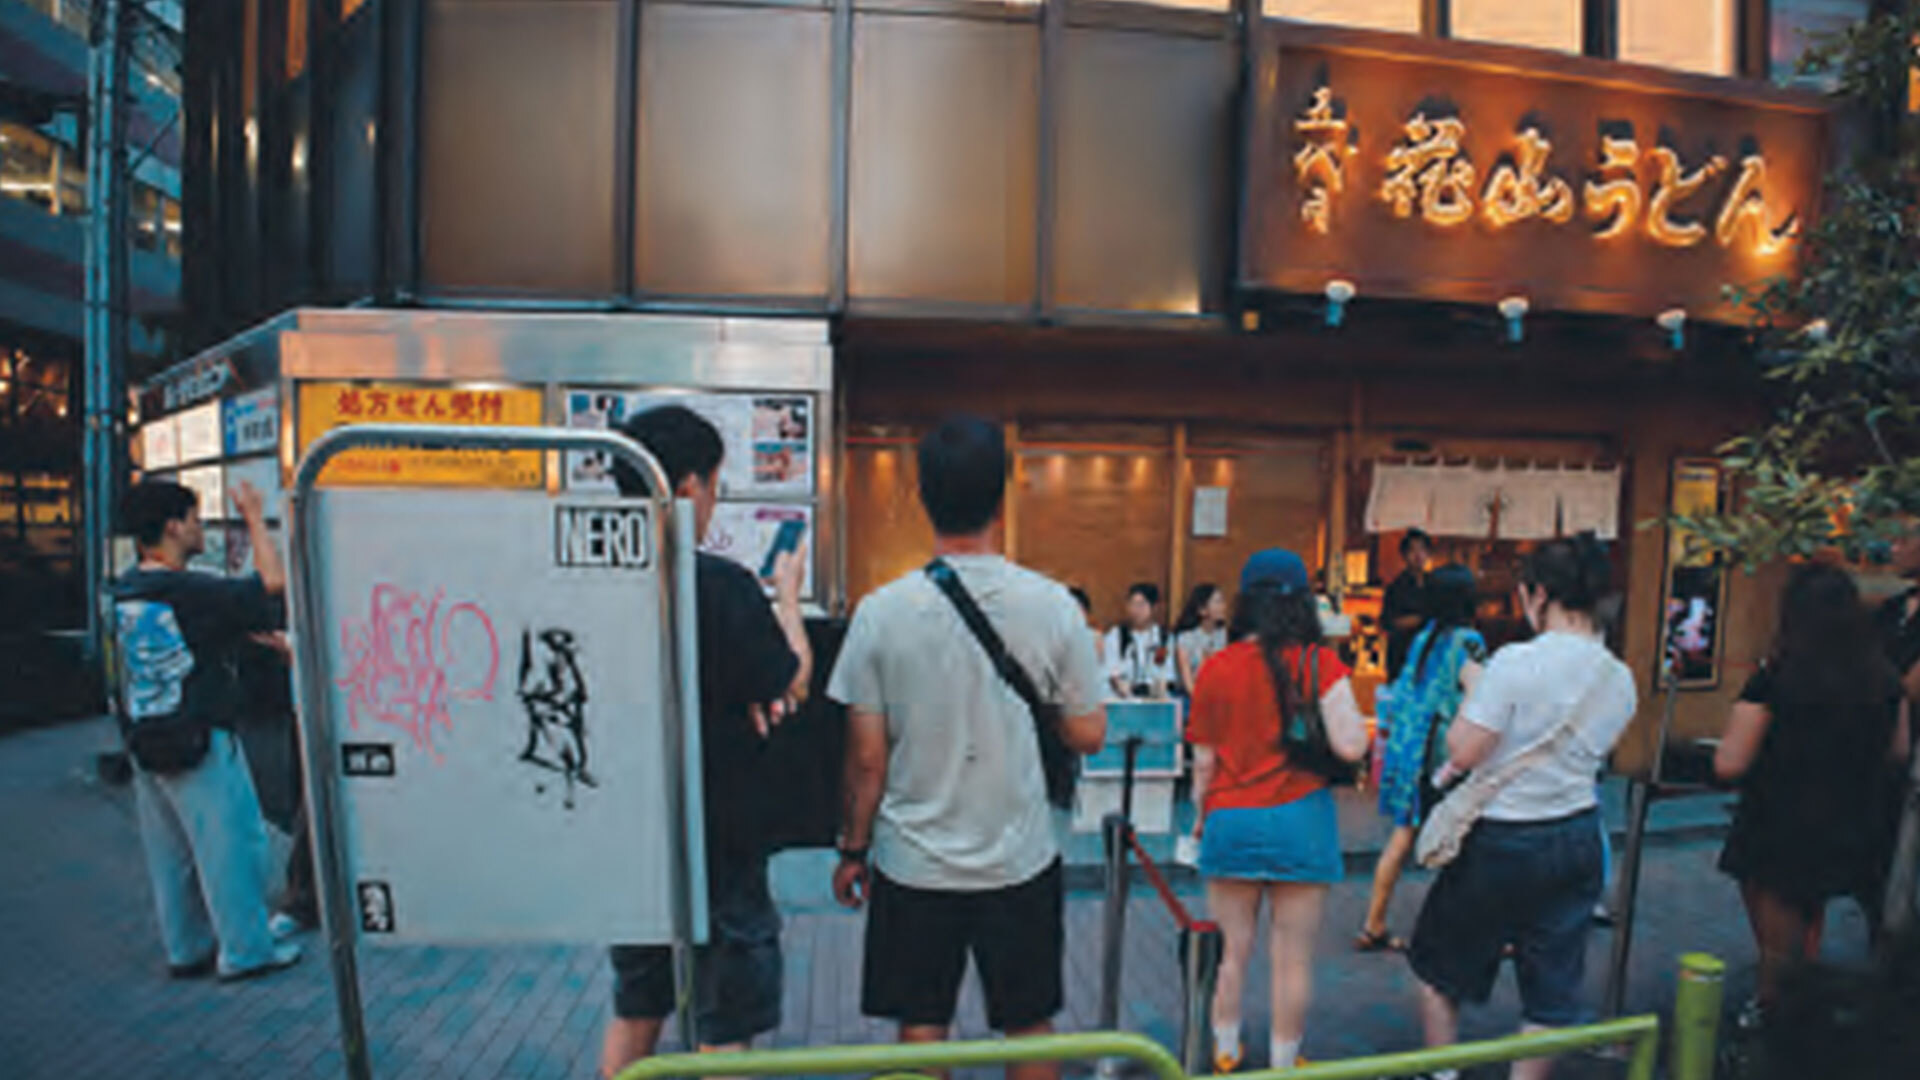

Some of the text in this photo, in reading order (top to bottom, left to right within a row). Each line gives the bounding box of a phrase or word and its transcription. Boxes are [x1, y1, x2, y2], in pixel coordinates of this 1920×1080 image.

[1381, 113, 1798, 256] 花山うどん
[337, 389, 503, 422] 処方せん受付
